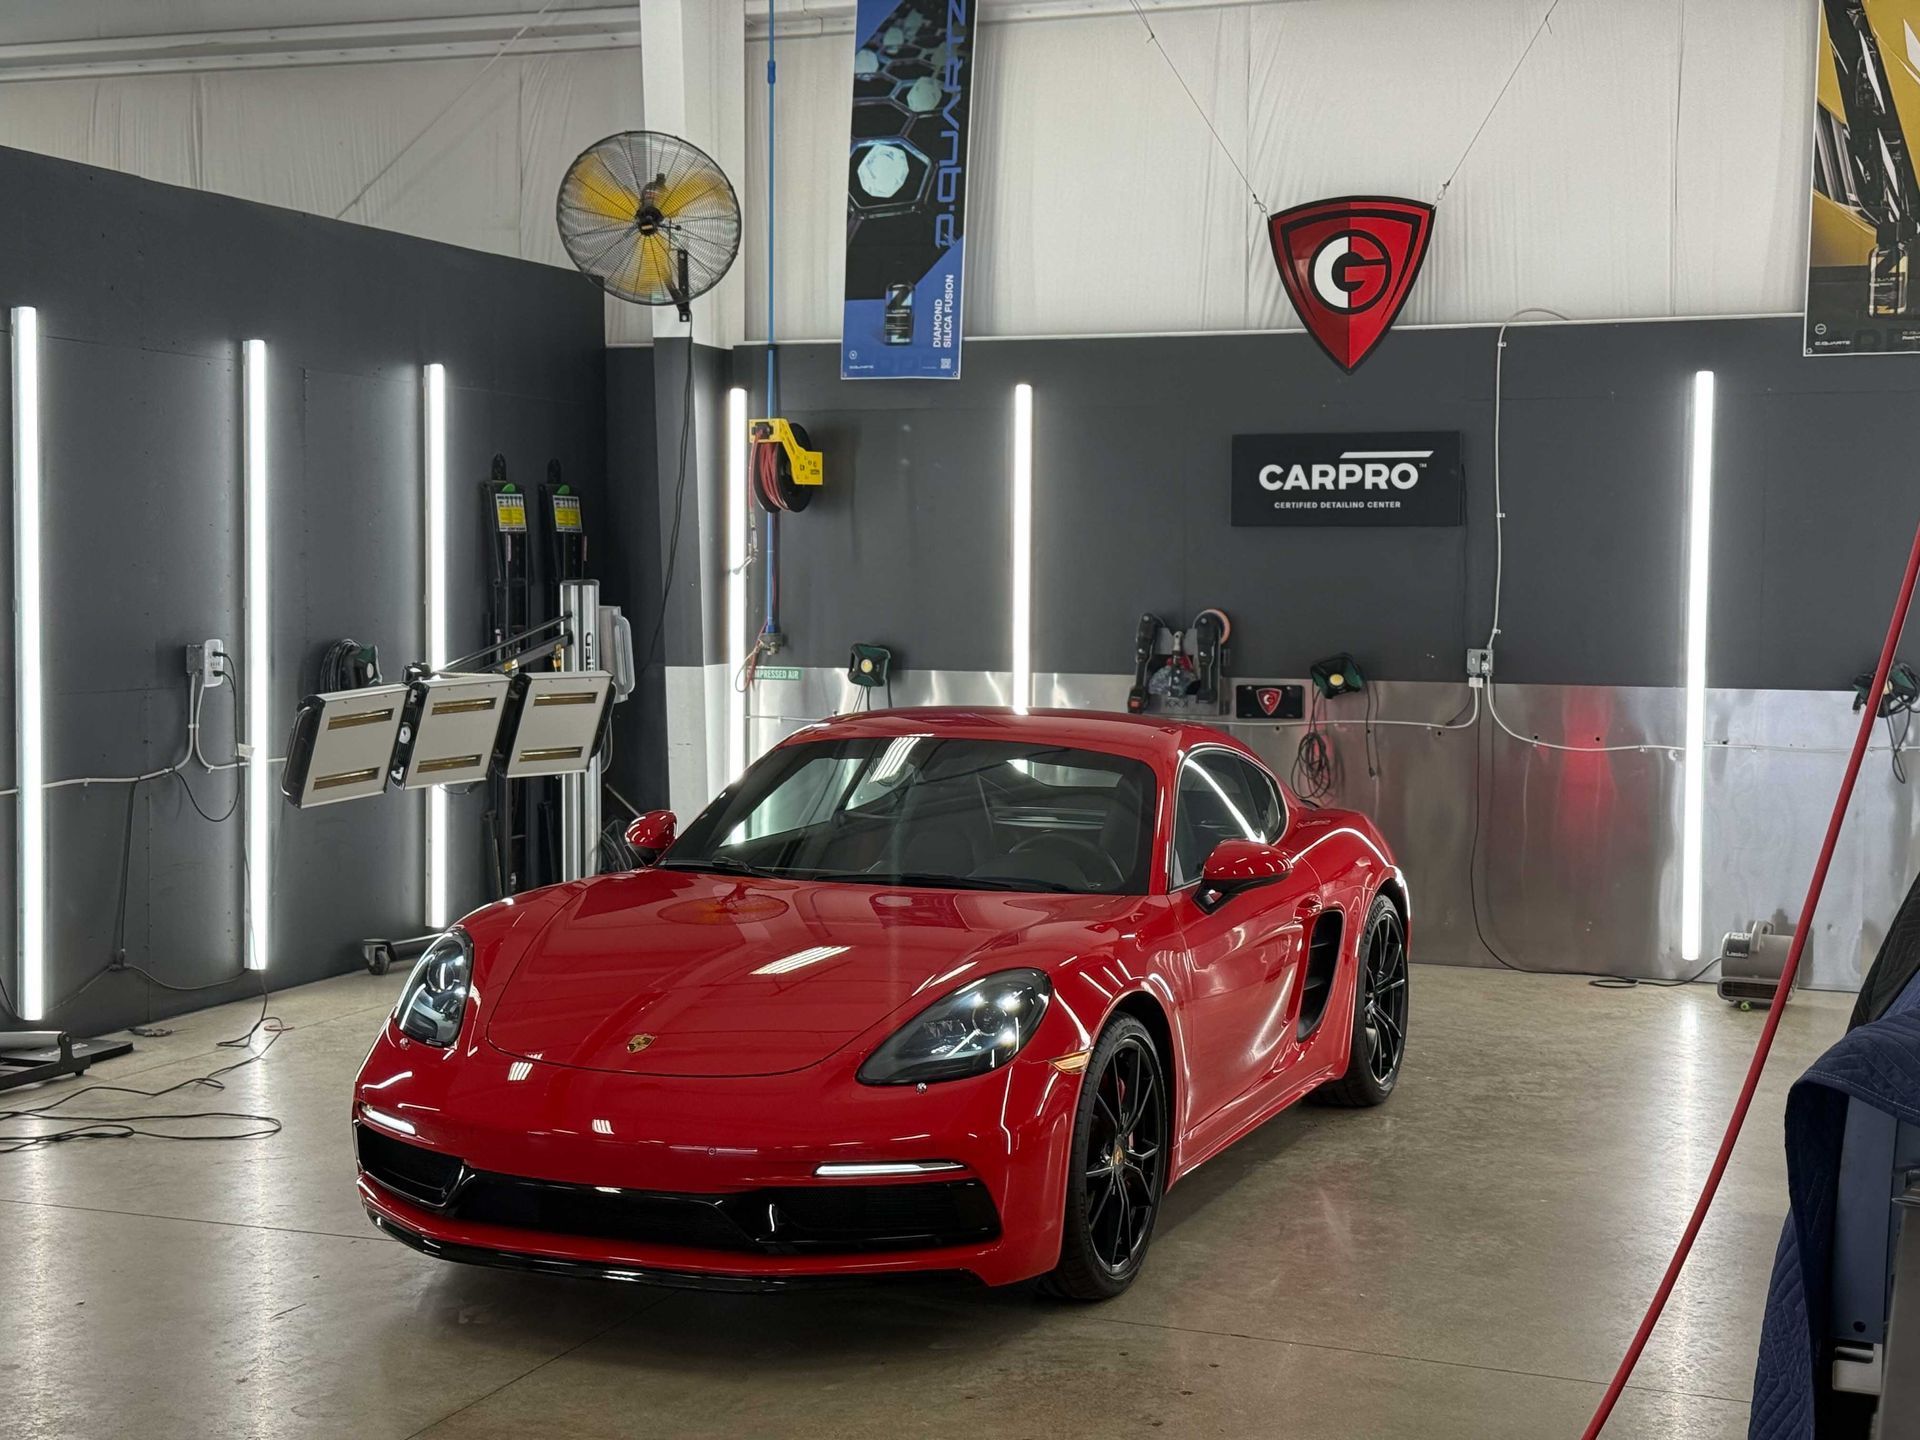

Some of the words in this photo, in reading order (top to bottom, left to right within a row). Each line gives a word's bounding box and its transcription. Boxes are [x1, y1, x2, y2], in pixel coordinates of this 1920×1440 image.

[944, 274, 954, 313] FUSION
[933, 298, 943, 348] DIAMOND
[943, 315, 953, 348] SILICA
[1259, 463, 1419, 491] CARPRO
[1274, 501, 1318, 509] CERTIFIED
[1320, 501, 1365, 509] DETAILING
[788, 670, 799, 680] AIR
